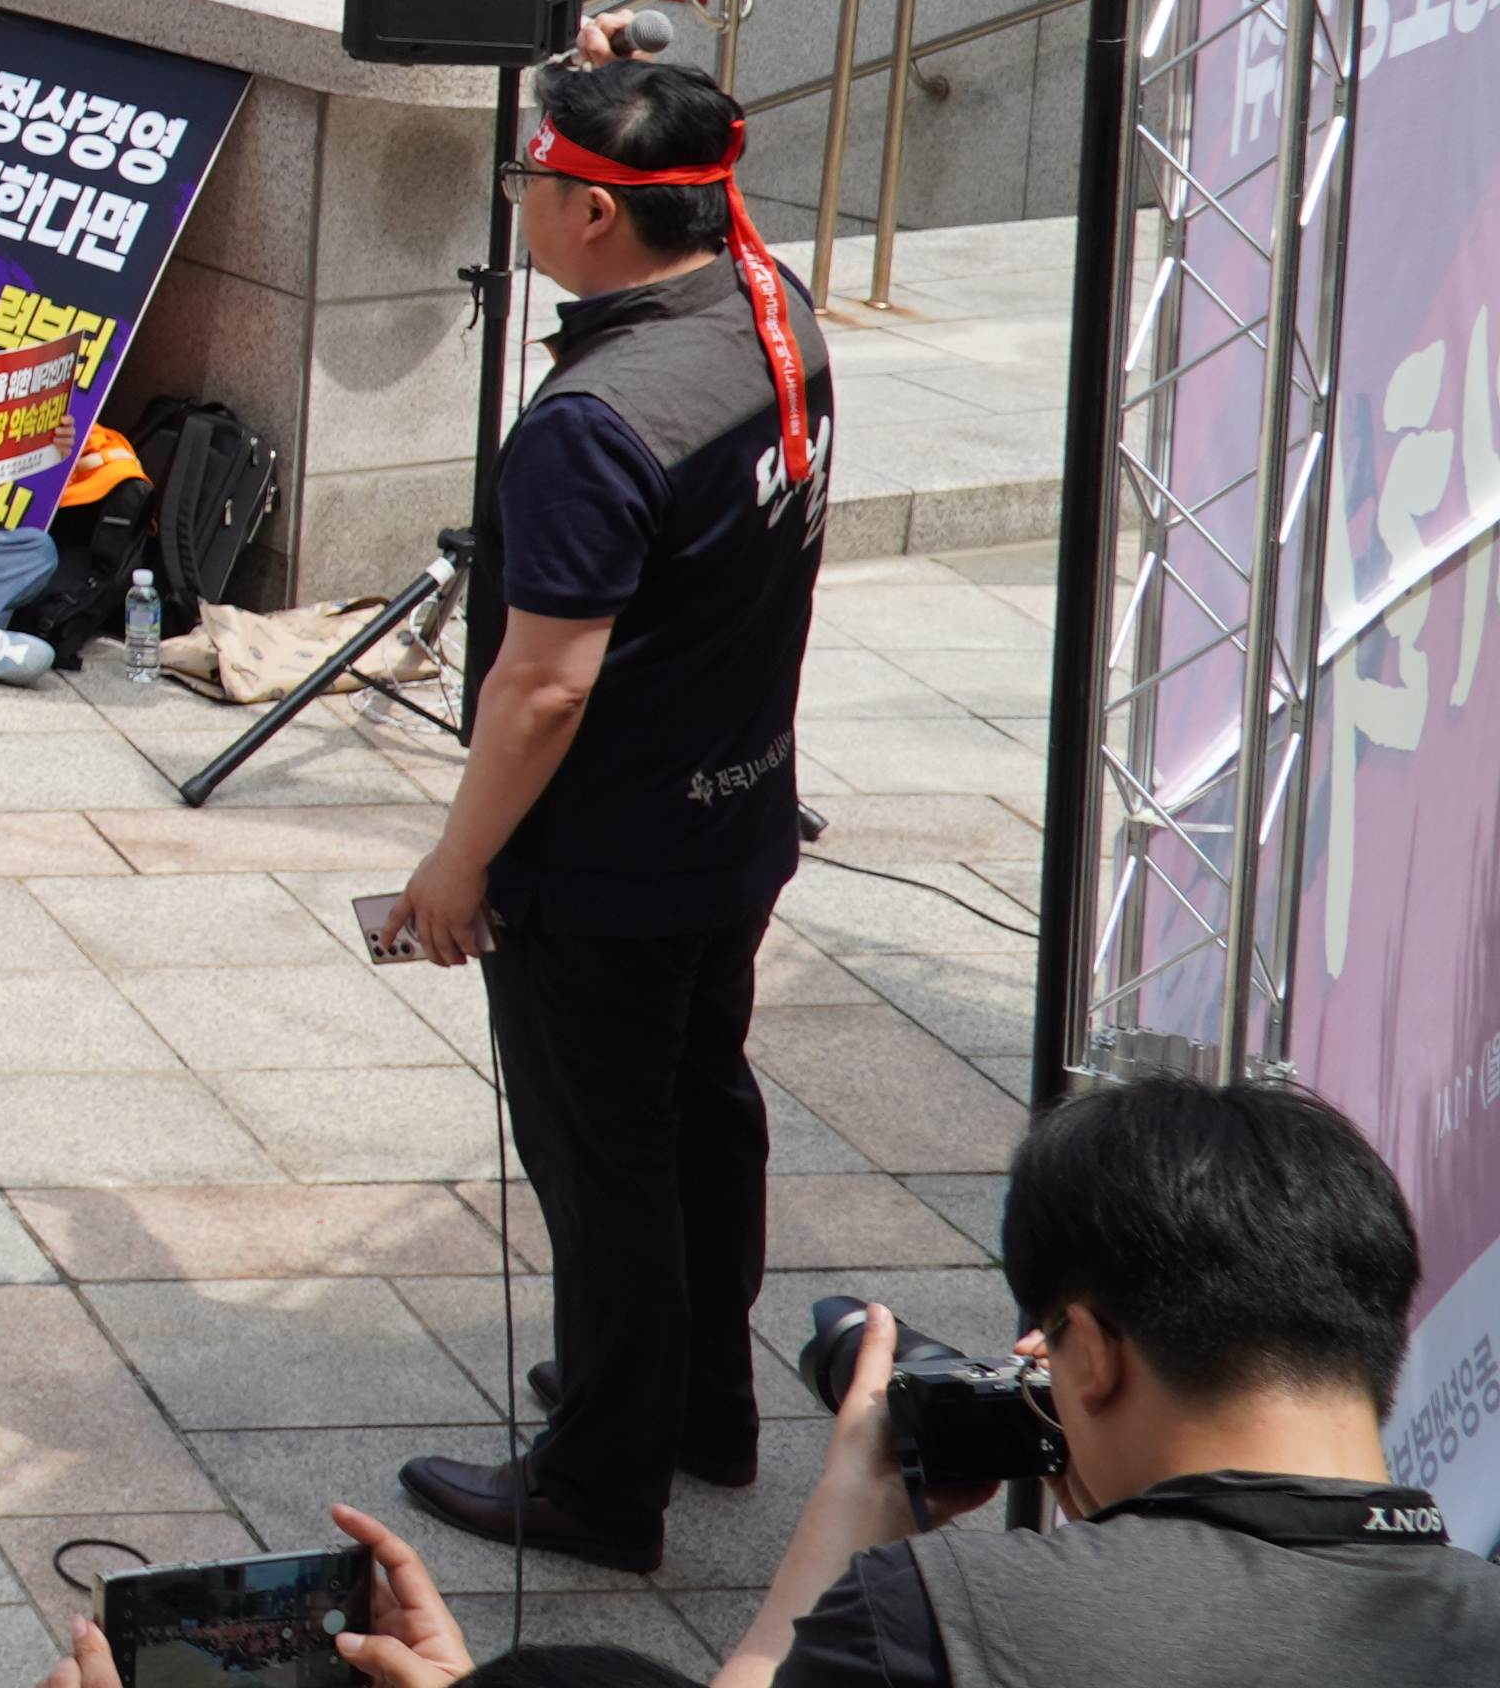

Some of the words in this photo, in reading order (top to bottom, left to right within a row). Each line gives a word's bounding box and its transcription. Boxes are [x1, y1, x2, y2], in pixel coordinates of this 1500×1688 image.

[9, 374, 32, 401] 위한
[10, 392, 68, 438] 약속하라!
[1364, 1505, 1443, 1535] SONY
